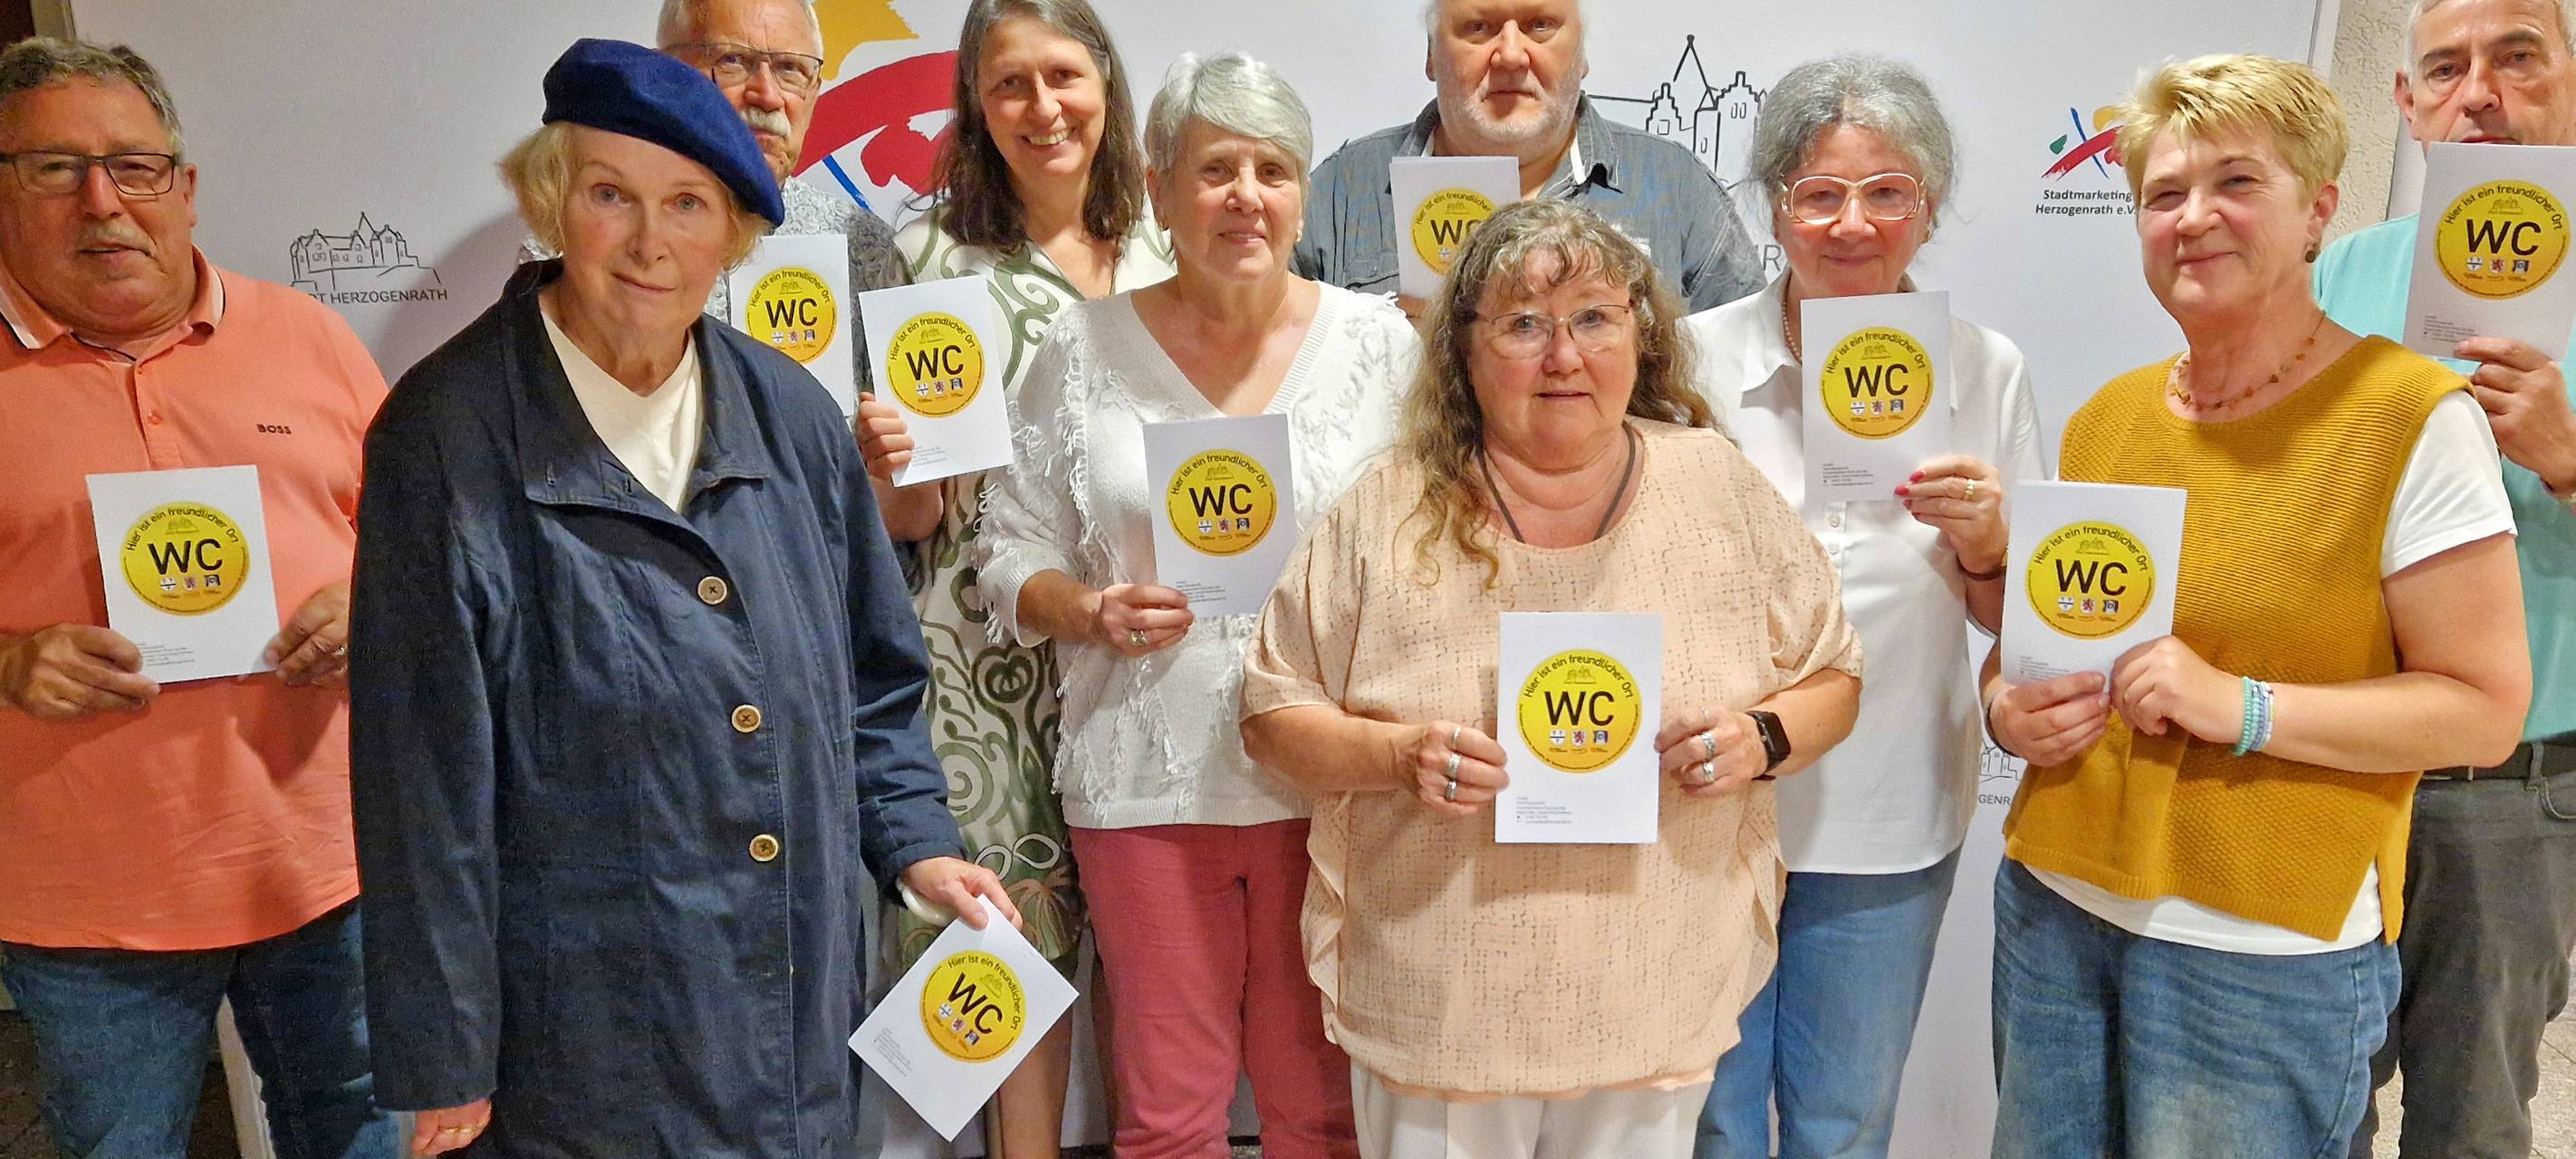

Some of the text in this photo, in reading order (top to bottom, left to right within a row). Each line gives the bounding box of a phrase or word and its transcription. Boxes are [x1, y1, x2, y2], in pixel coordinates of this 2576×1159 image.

[2036, 205, 2112, 216] Herzogenrath
[2043, 189, 2132, 202] Stadtmarketing
[2445, 206, 2462, 225] Hier
[2463, 195, 2475, 206] ist
[2477, 188, 2494, 199] ein
[2497, 185, 2556, 216] freundlicher
[1430, 219, 1481, 244] W
[2465, 219, 2542, 255] WC
[331, 289, 447, 303] HERZOGENRATH
[750, 271, 831, 307] Hier ist ein freundlicher Ort
[765, 298, 818, 329] WC
[890, 318, 976, 360] Hier ist ein freundlicher Ort
[1826, 332, 1926, 374] Hier ist ein freundlicher Ort
[906, 345, 964, 381] WC
[1844, 364, 1908, 398] WC
[255, 423, 292, 435] BOSS
[1171, 455, 1267, 495] Hier ist ein freundlicher Ort
[1189, 484, 1253, 517] WC
[126, 508, 239, 551] Hier ist ein freundlicher Ort
[148, 539, 223, 575] WC
[2034, 526, 2148, 572] Hier ist ein freundlicher Ort
[2055, 559, 2128, 596] WC
[1525, 655, 1633, 698] Hier ist ein freundlicher Ort
[1544, 691, 1615, 726] WC
[947, 972, 1003, 1035] WC
[948, 954, 1021, 1030] Hier ist ein freundlicher Ort
